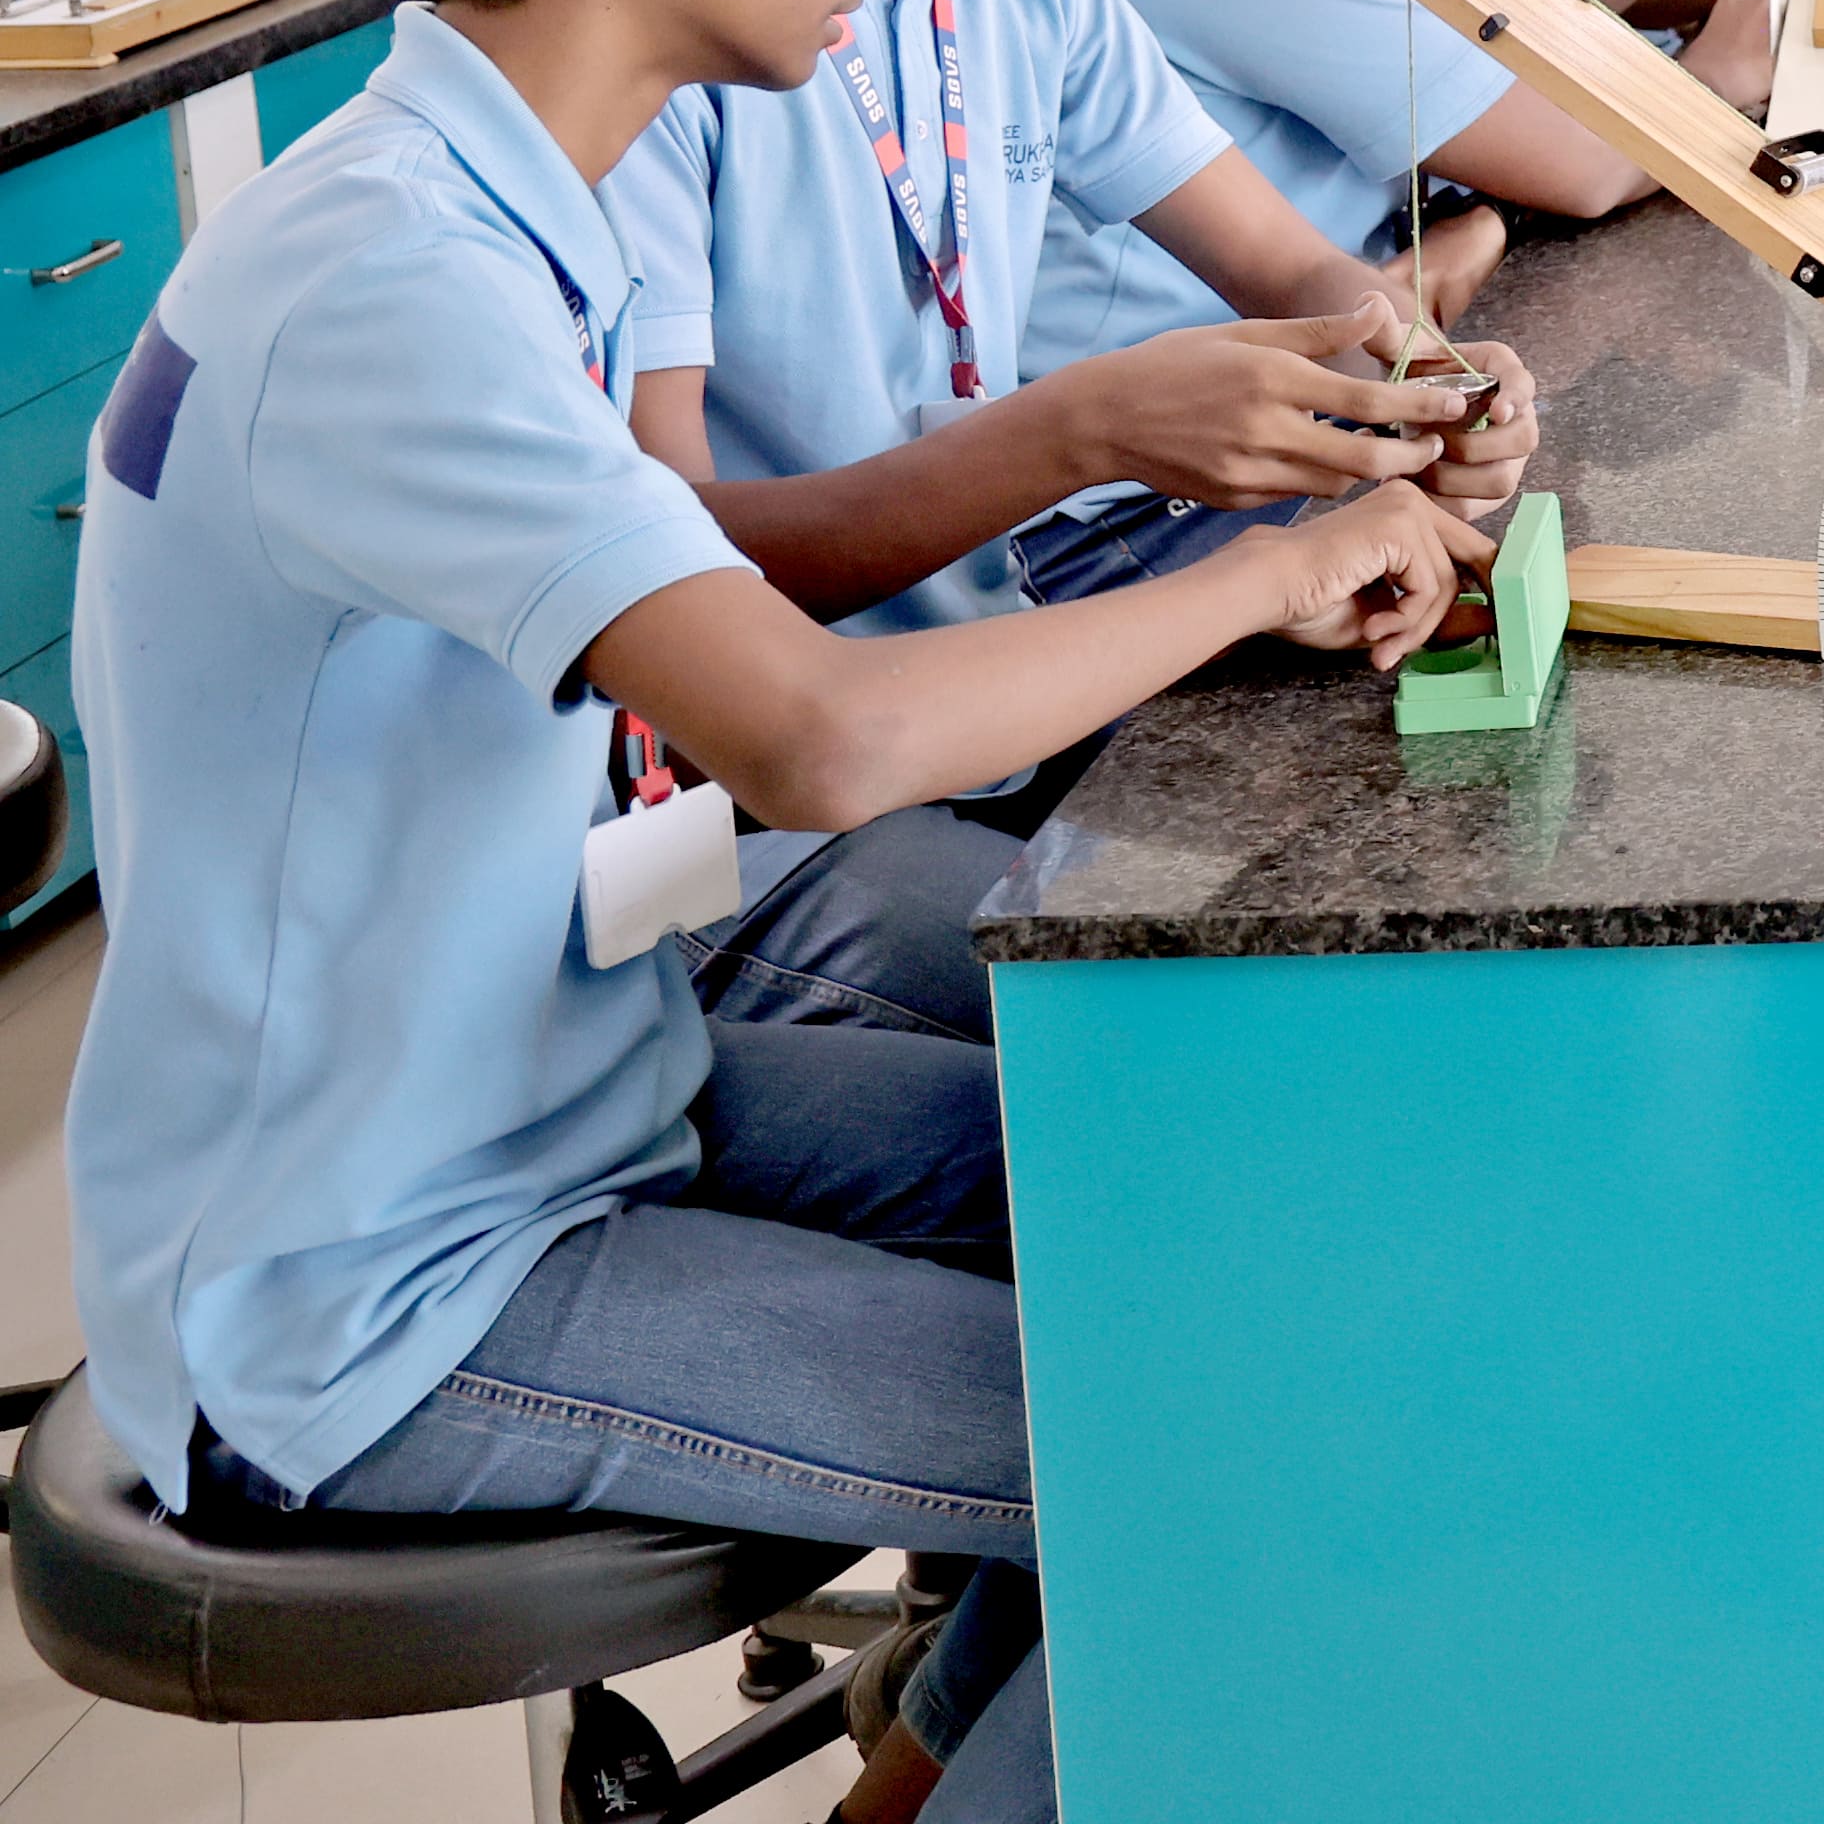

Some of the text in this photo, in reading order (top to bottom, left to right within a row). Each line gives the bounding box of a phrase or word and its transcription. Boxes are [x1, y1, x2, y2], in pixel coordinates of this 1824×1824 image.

[846, 56, 886, 125] SGVS
[943, 44, 963, 110] SGVS
[953, 173, 969, 239] SGVS
